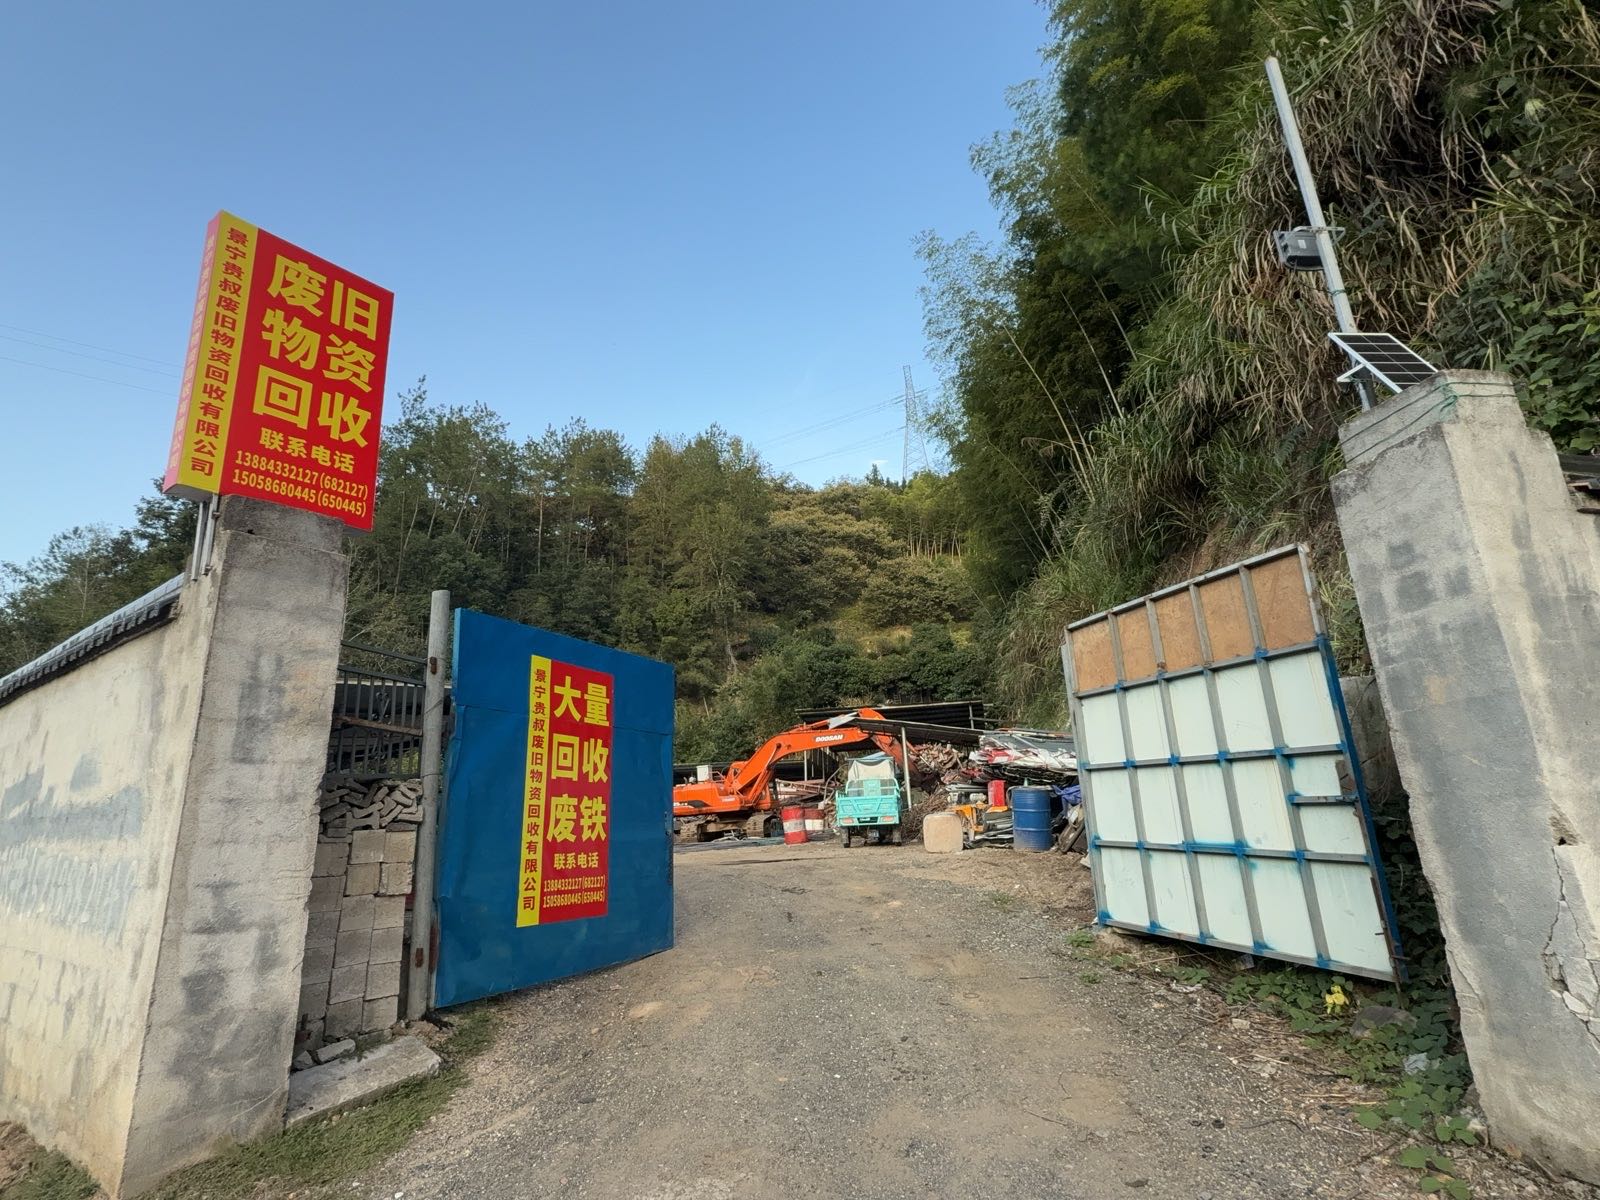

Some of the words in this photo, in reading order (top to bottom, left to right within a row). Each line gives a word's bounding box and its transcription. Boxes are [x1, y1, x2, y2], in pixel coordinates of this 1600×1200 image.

[266, 254, 379, 341] 废旧
[191, 227, 249, 477] 景宁贵叔废旧物资回收有限公司
[261, 309, 376, 393] 物资
[253, 364, 372, 448] 回收
[235, 450, 368, 500] 13884332127(682127)
[259, 427, 355, 474] 联系电话
[232, 469, 367, 518] 15058680445(650445)
[553, 675, 611, 727] 大量
[551, 733, 609, 783] 回收
[815, 734, 844, 743] DOOSAN
[522, 668, 547, 912] 景宁贵叔废旧物资回收有限公司
[546, 793, 607, 843] 废铁
[553, 851, 599, 870] 联系电话
